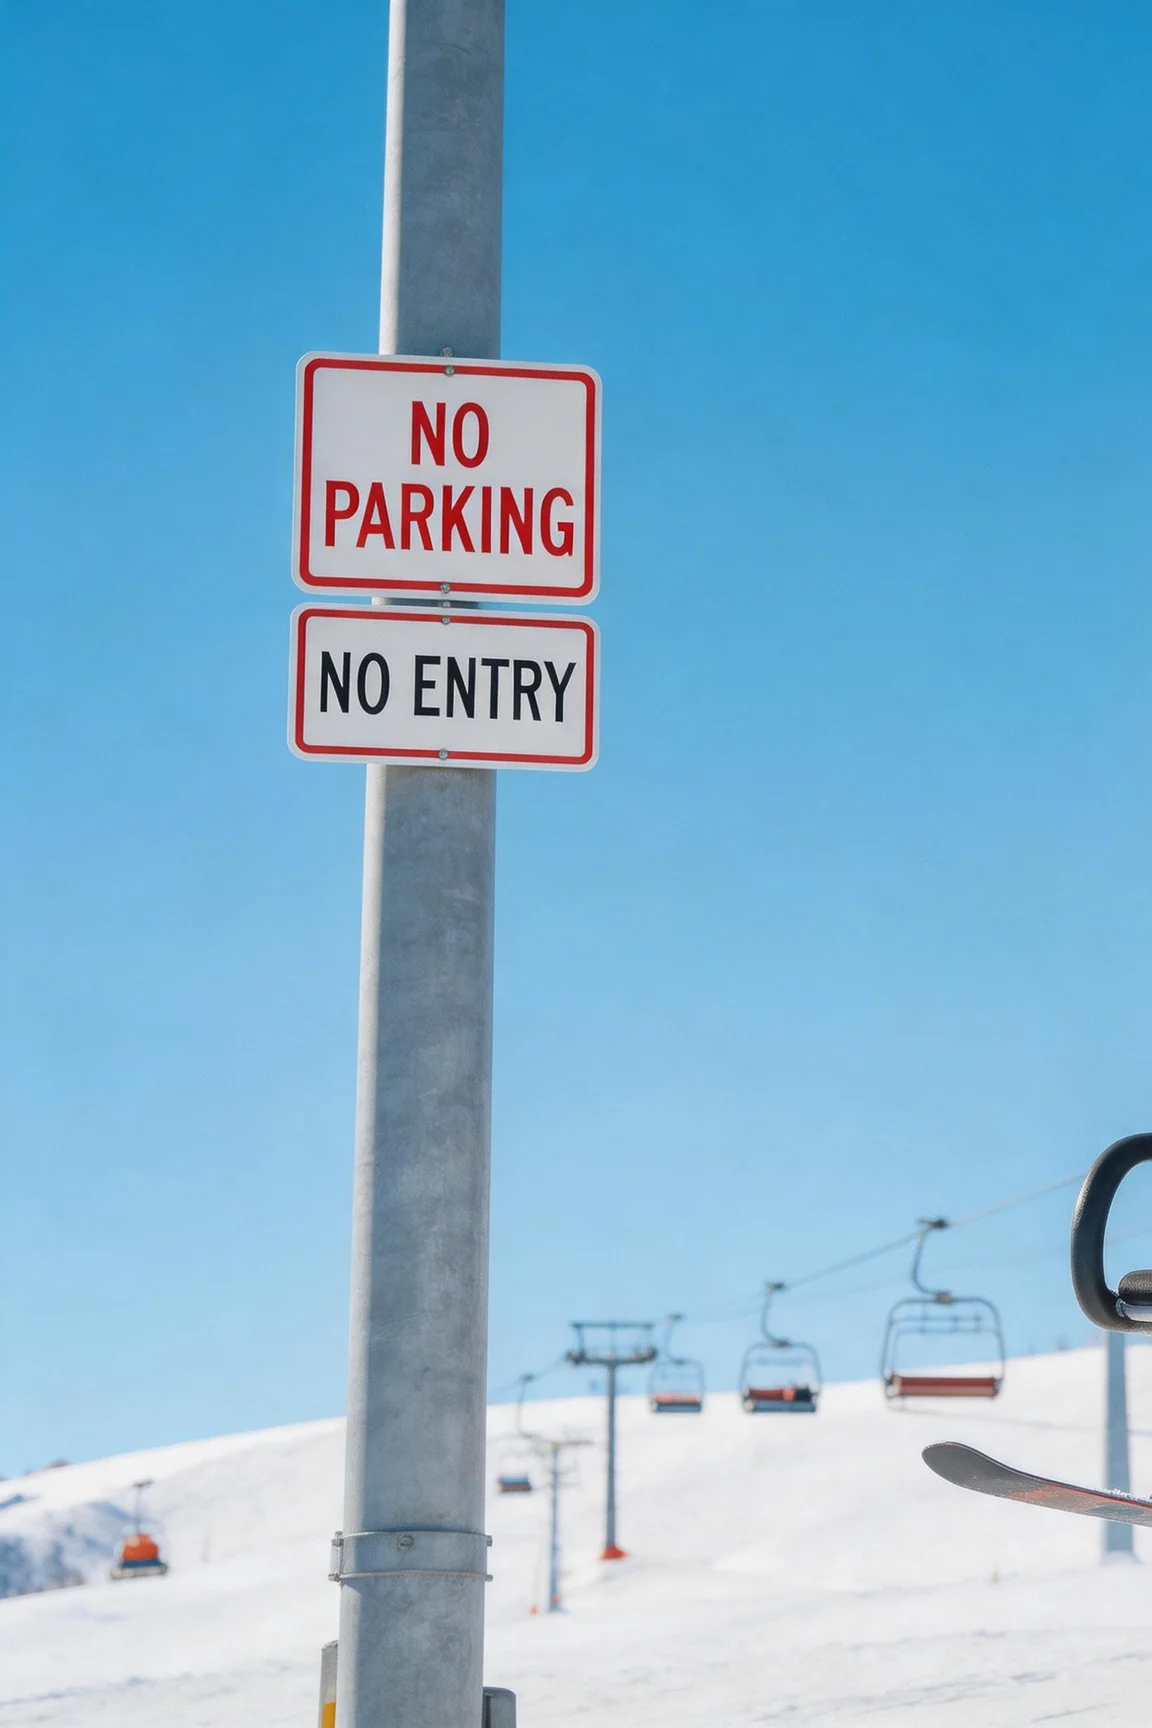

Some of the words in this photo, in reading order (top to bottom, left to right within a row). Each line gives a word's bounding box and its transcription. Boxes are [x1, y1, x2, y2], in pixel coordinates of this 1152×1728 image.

[411, 400, 489, 468] NO
[324, 480, 575, 557] PARKING
[320, 651, 390, 715] NO
[413, 654, 577, 723] ENTRY
